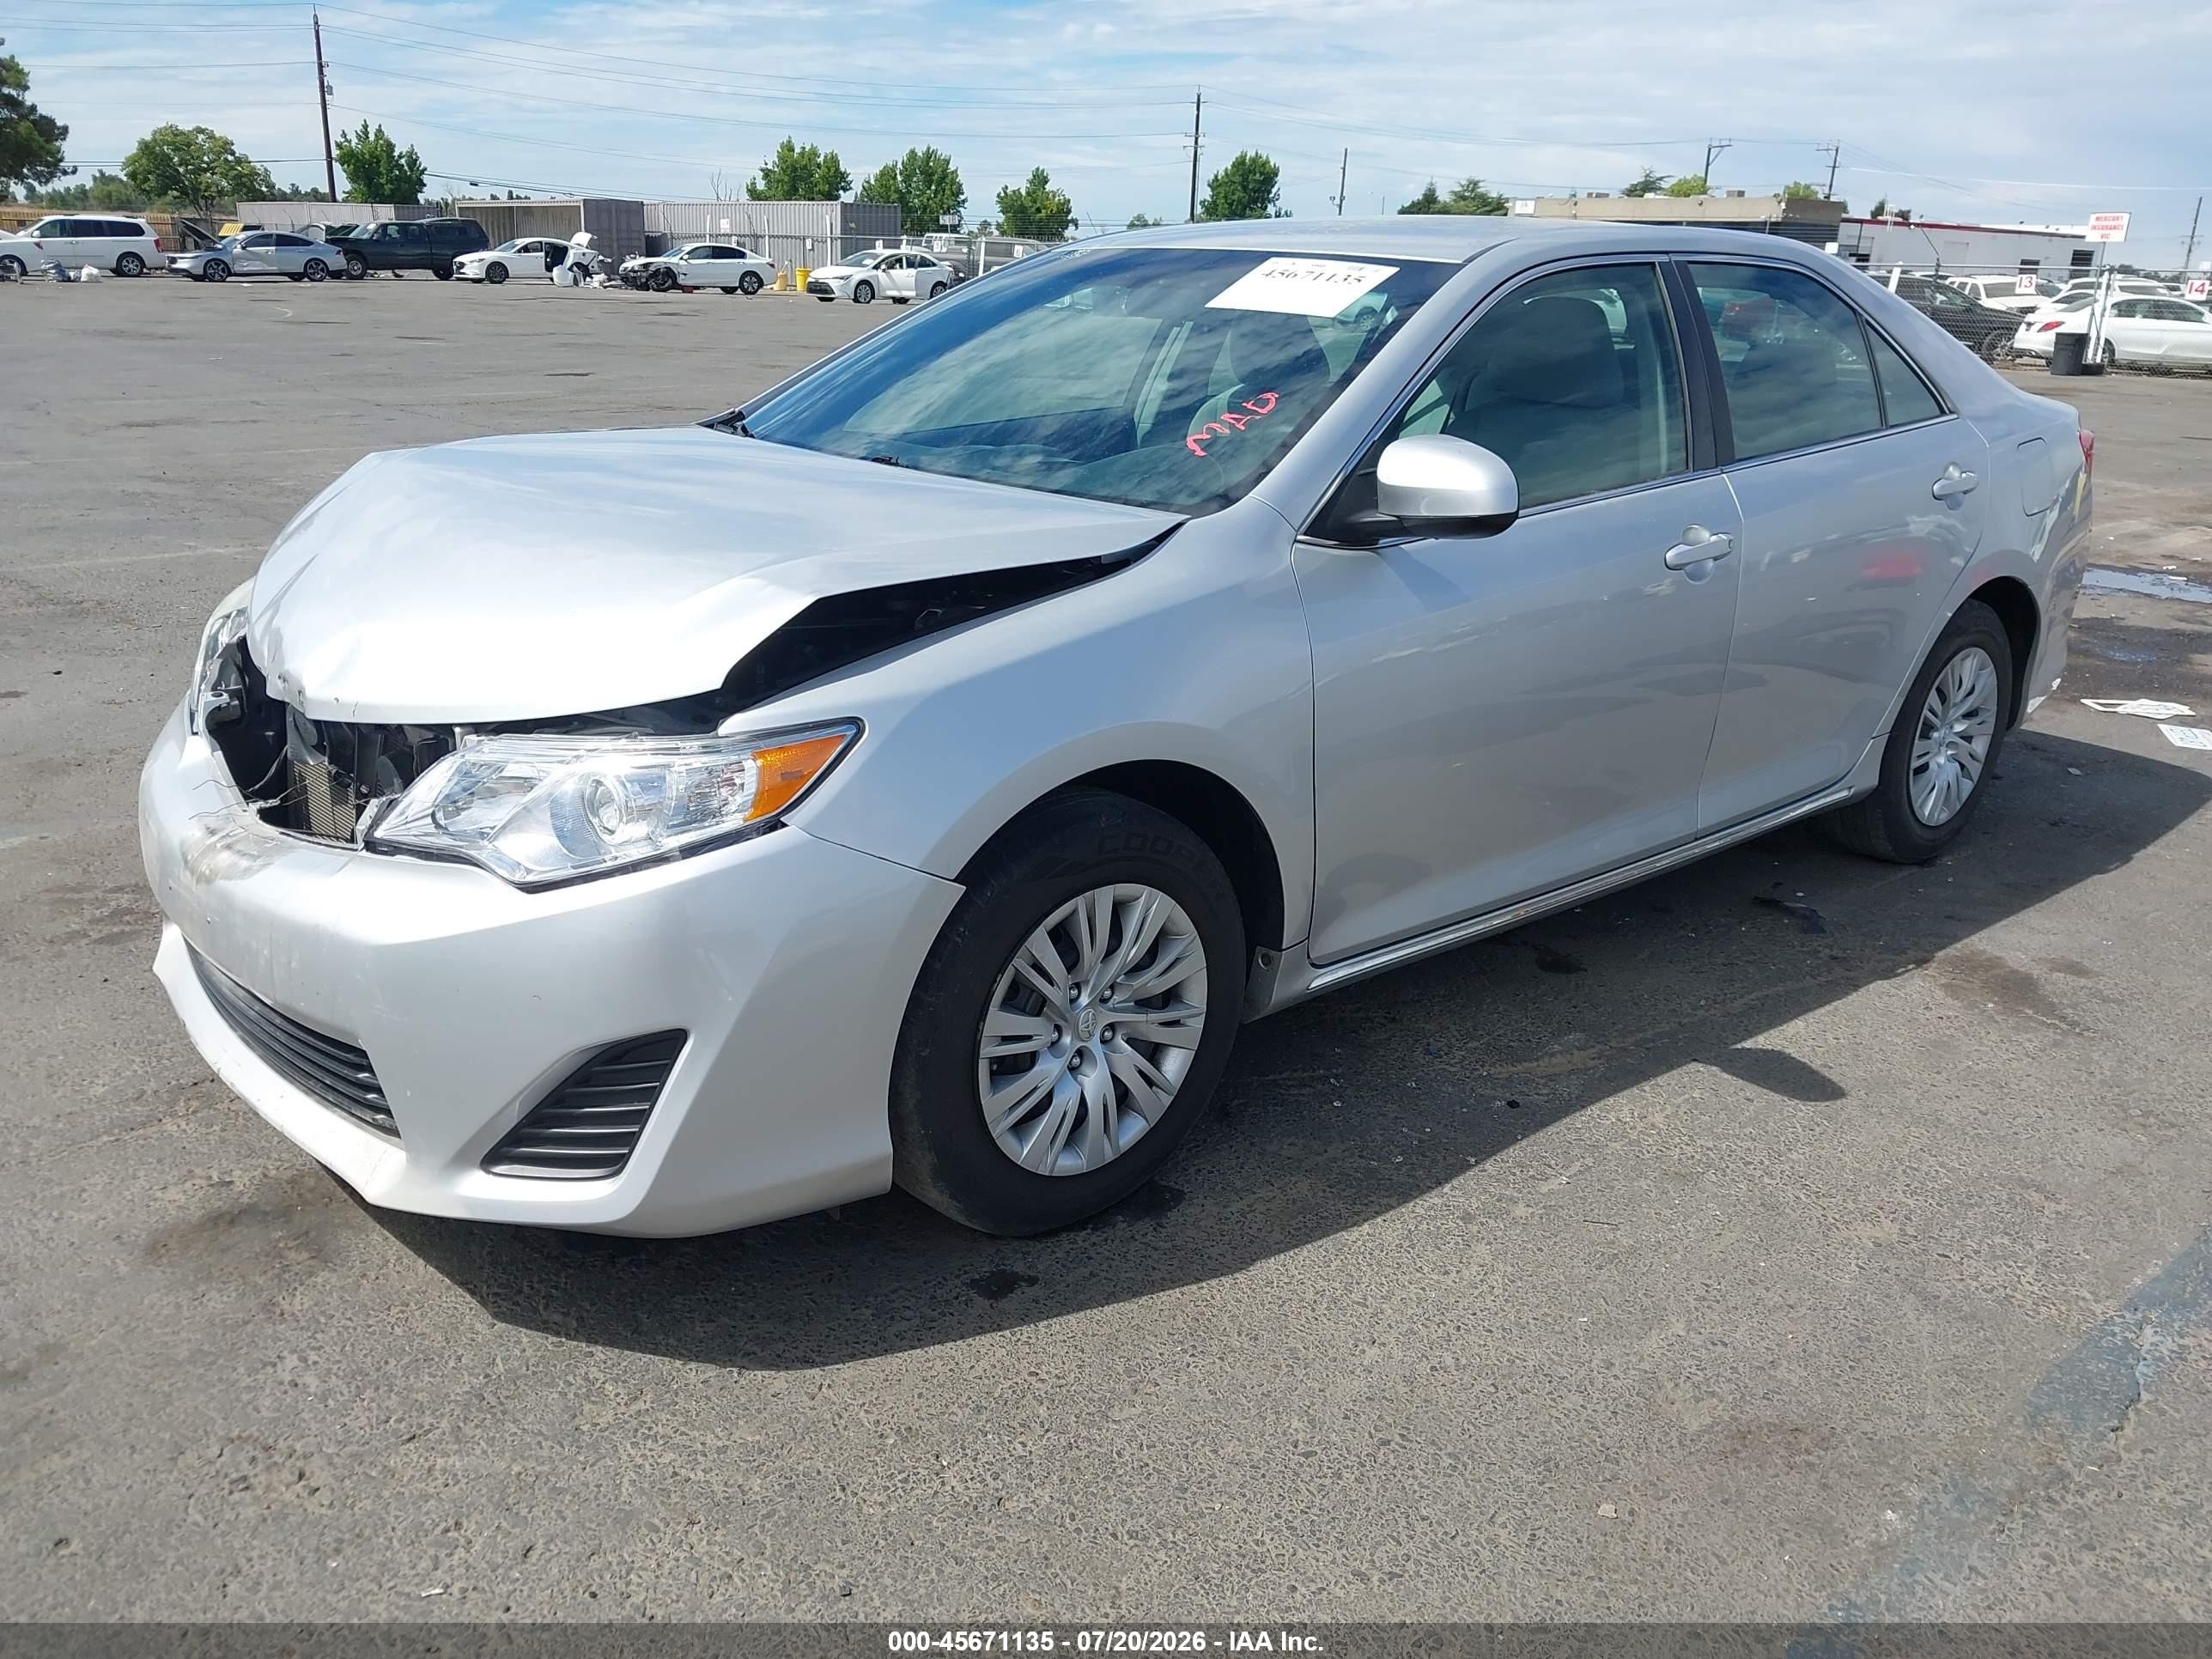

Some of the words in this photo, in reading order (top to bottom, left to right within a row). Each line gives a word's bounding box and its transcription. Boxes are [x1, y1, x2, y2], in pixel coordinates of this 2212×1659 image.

[1261, 269, 1367, 284] 45671135
[2019, 276, 2033, 289] 13
[2189, 282, 2206, 295] 14
